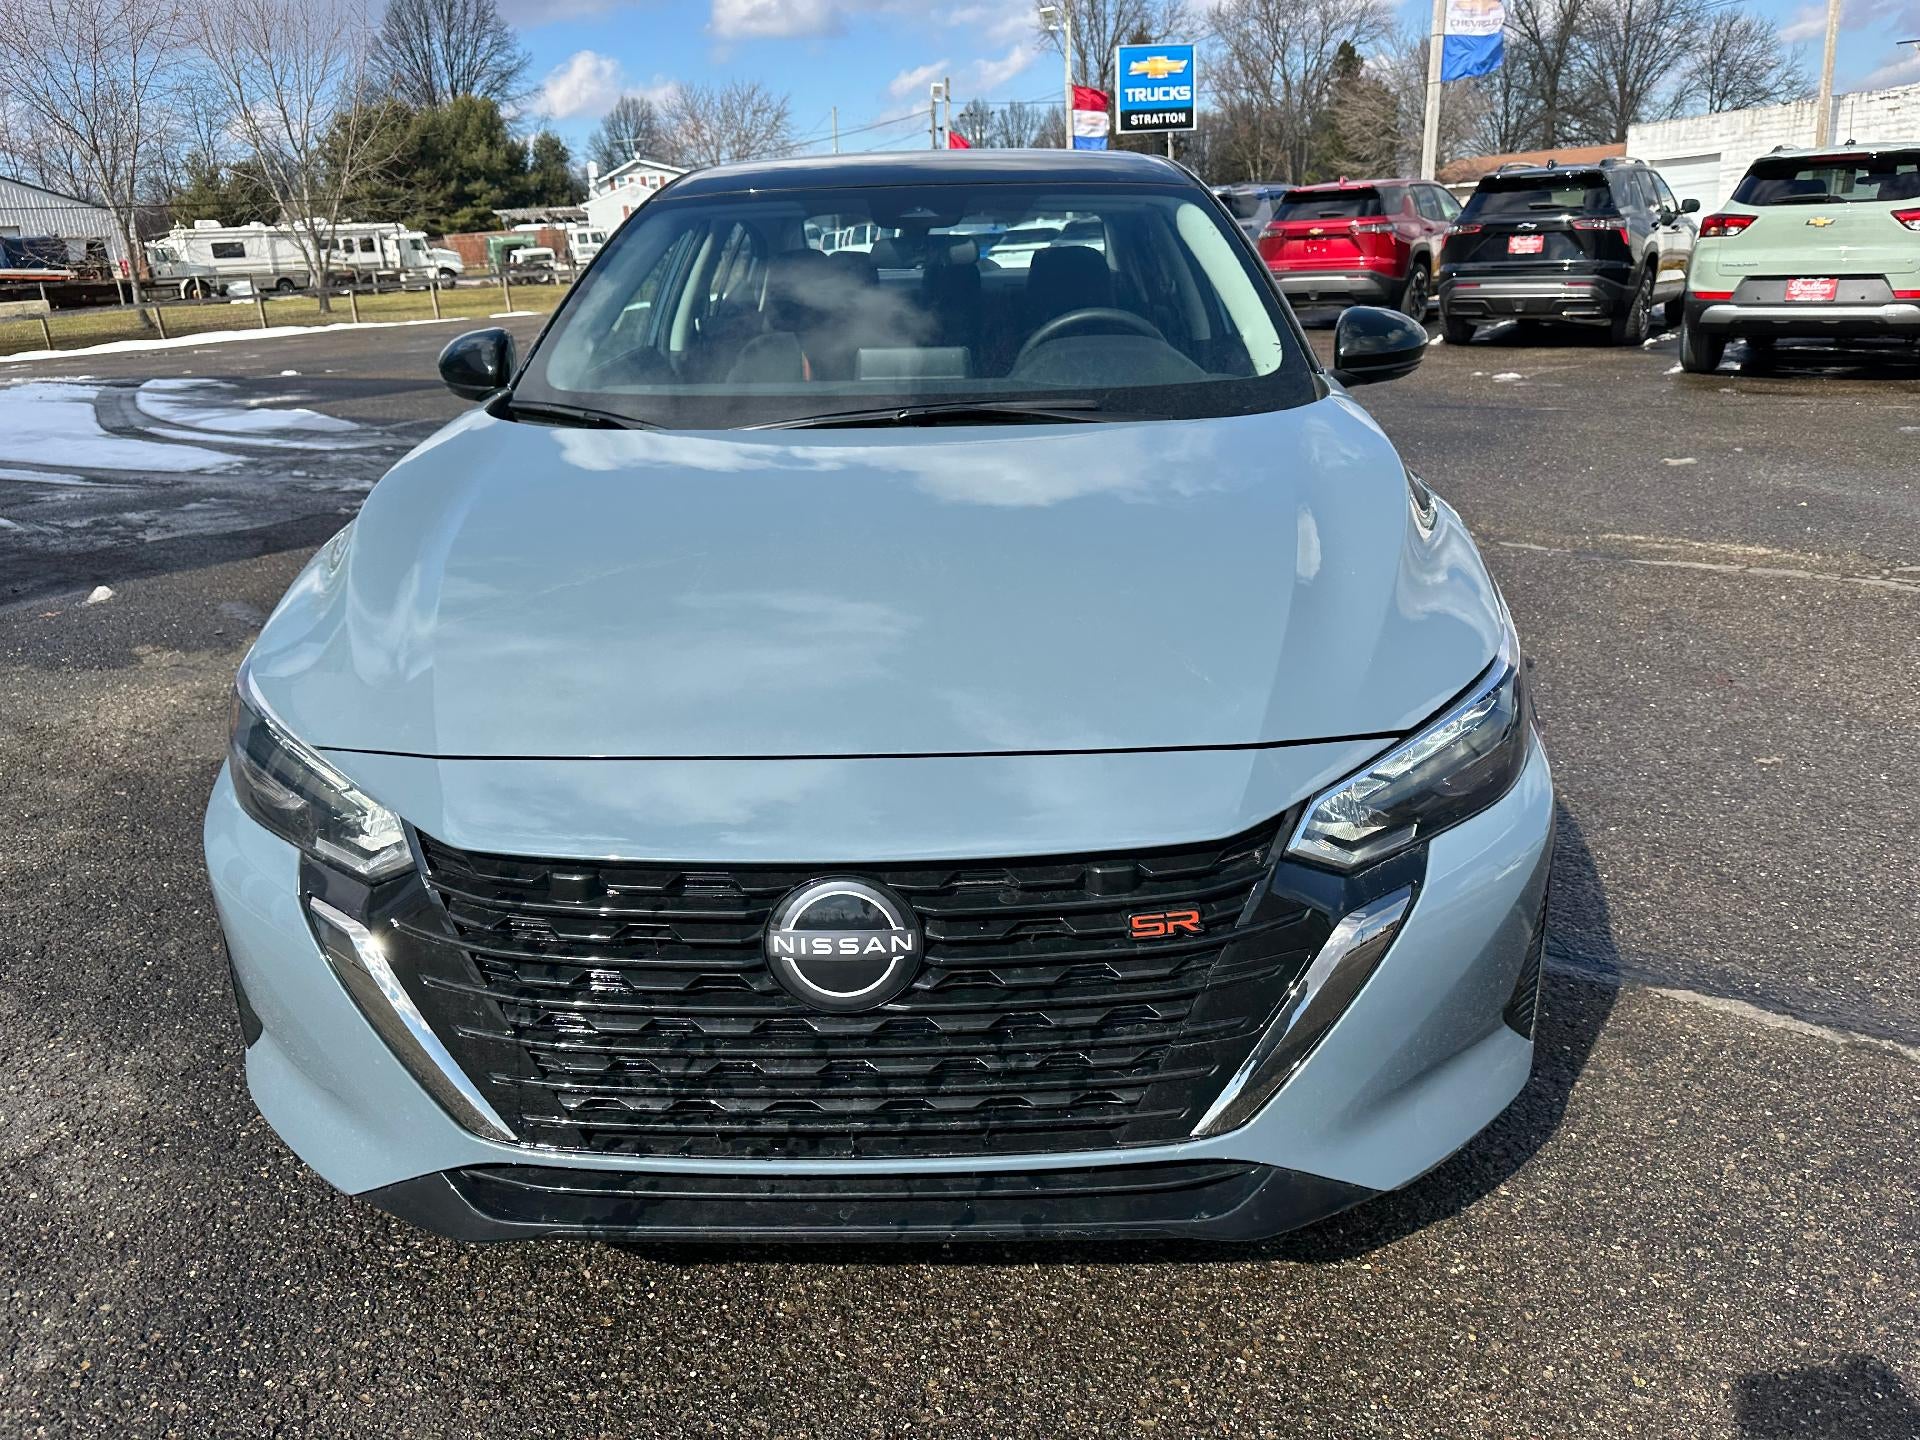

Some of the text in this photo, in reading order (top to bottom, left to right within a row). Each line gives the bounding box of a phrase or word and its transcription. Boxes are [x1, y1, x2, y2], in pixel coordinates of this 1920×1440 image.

[1125, 86, 1191, 102] TRUCKS
[1131, 113, 1186, 125] STRATTON
[1131, 910, 1204, 937] SR
[773, 934, 912, 955] NISSAN
